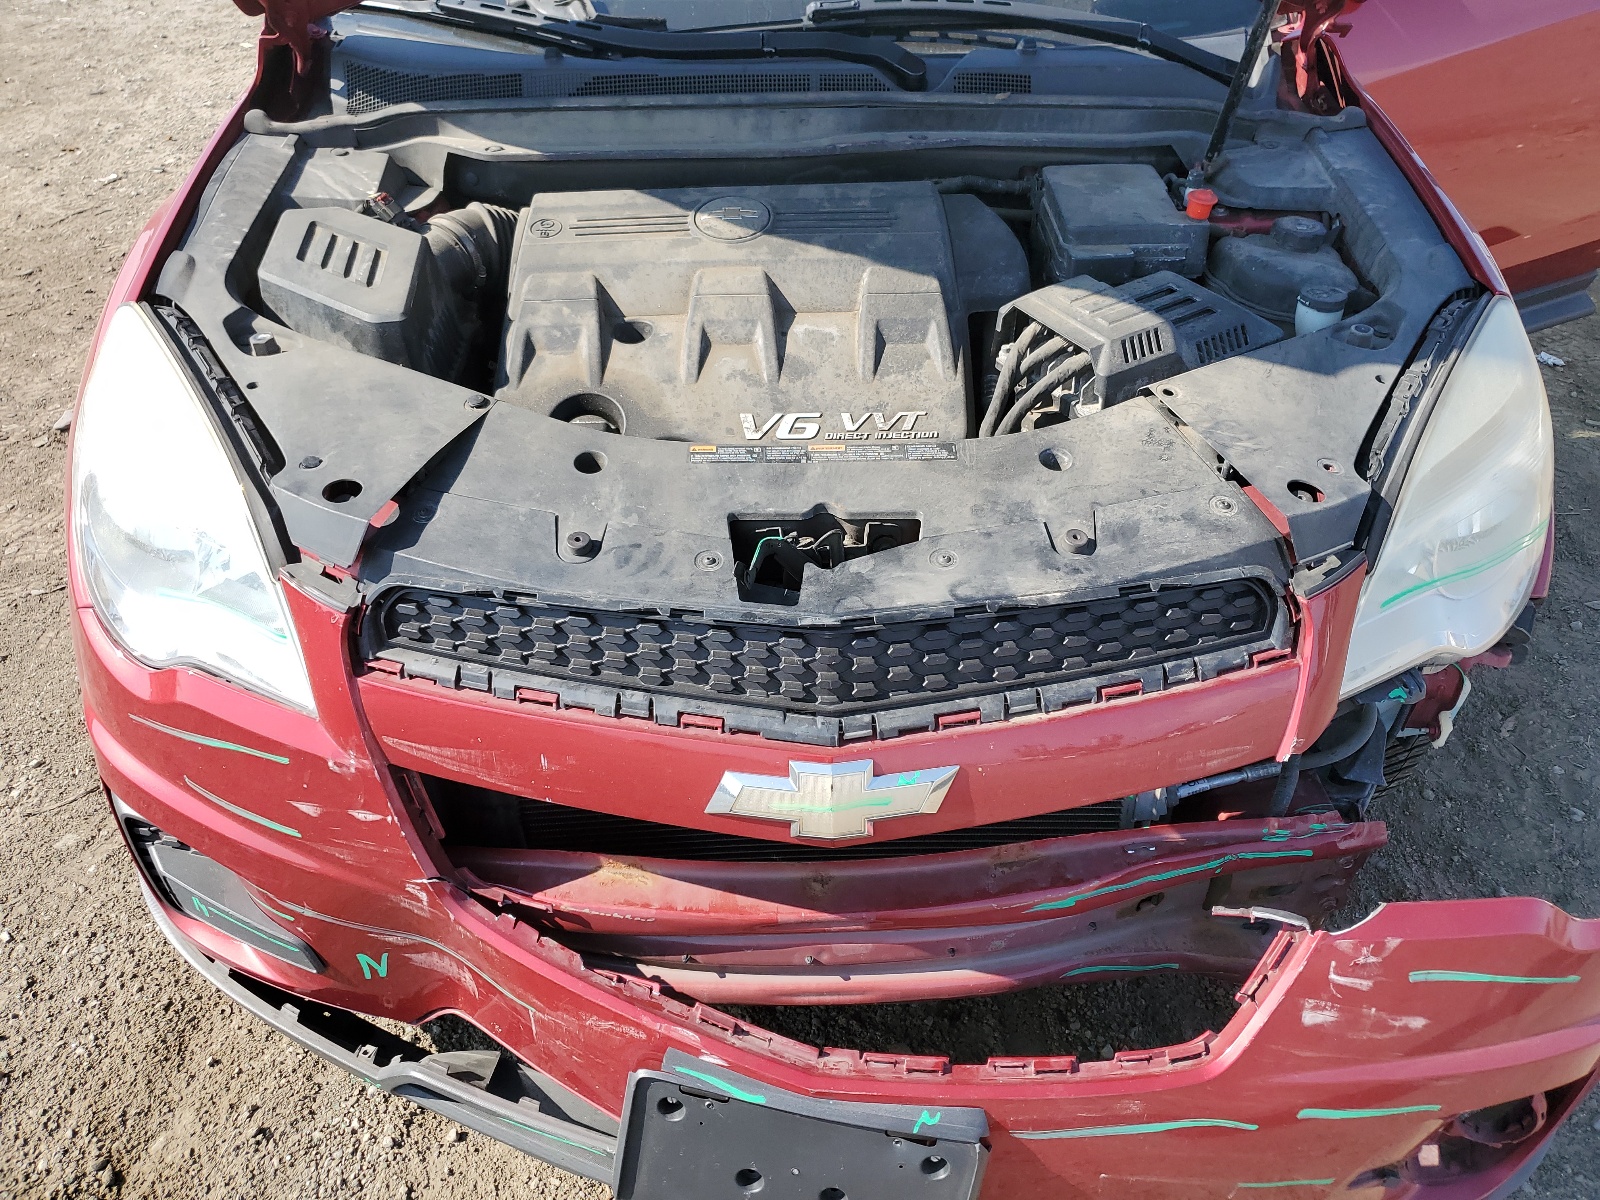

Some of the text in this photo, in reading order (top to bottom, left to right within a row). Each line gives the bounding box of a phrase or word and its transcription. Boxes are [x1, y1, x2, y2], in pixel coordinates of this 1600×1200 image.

[740, 411, 928, 441] V6 VVT
[825, 431, 939, 441] DIRECT INJECTION
